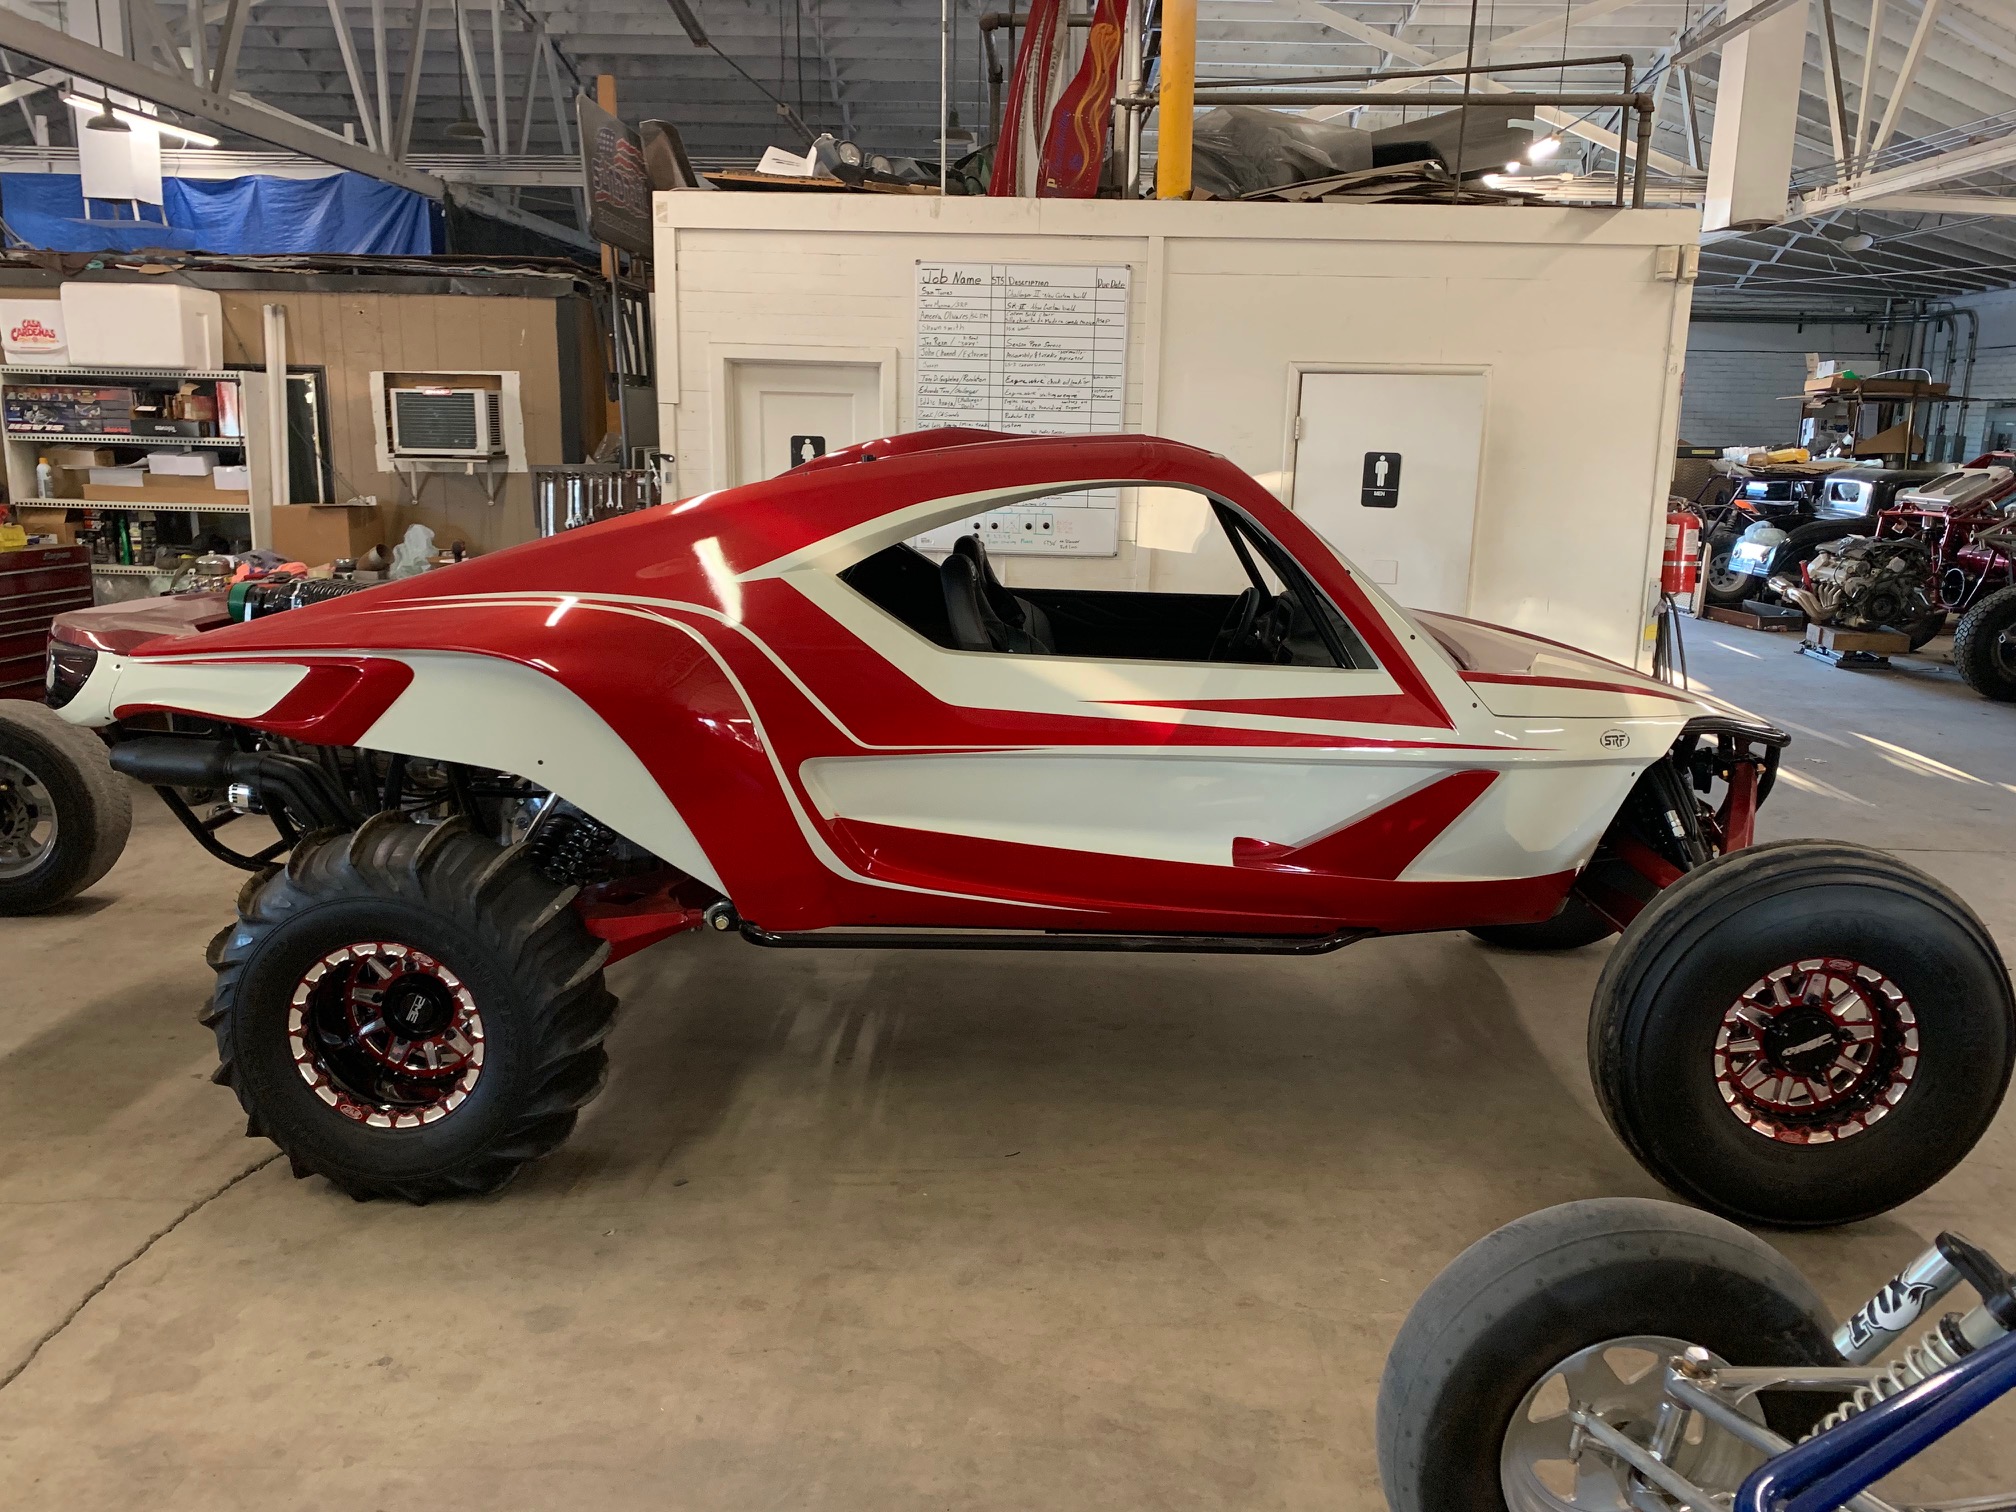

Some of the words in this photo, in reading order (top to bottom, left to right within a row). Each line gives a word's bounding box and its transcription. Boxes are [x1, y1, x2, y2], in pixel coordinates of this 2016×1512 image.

[922, 268, 948, 285] Job
[952, 271, 982, 285] Name
[991, 276, 1004, 286] STS
[1008, 276, 1049, 287] Description
[1097, 278, 1109, 288] Due
[1110, 280, 1125, 289] Date
[22, 319, 42, 329] CASA
[11, 328, 56, 342] CARDENAS
[1604, 734, 1626, 748] SRF
